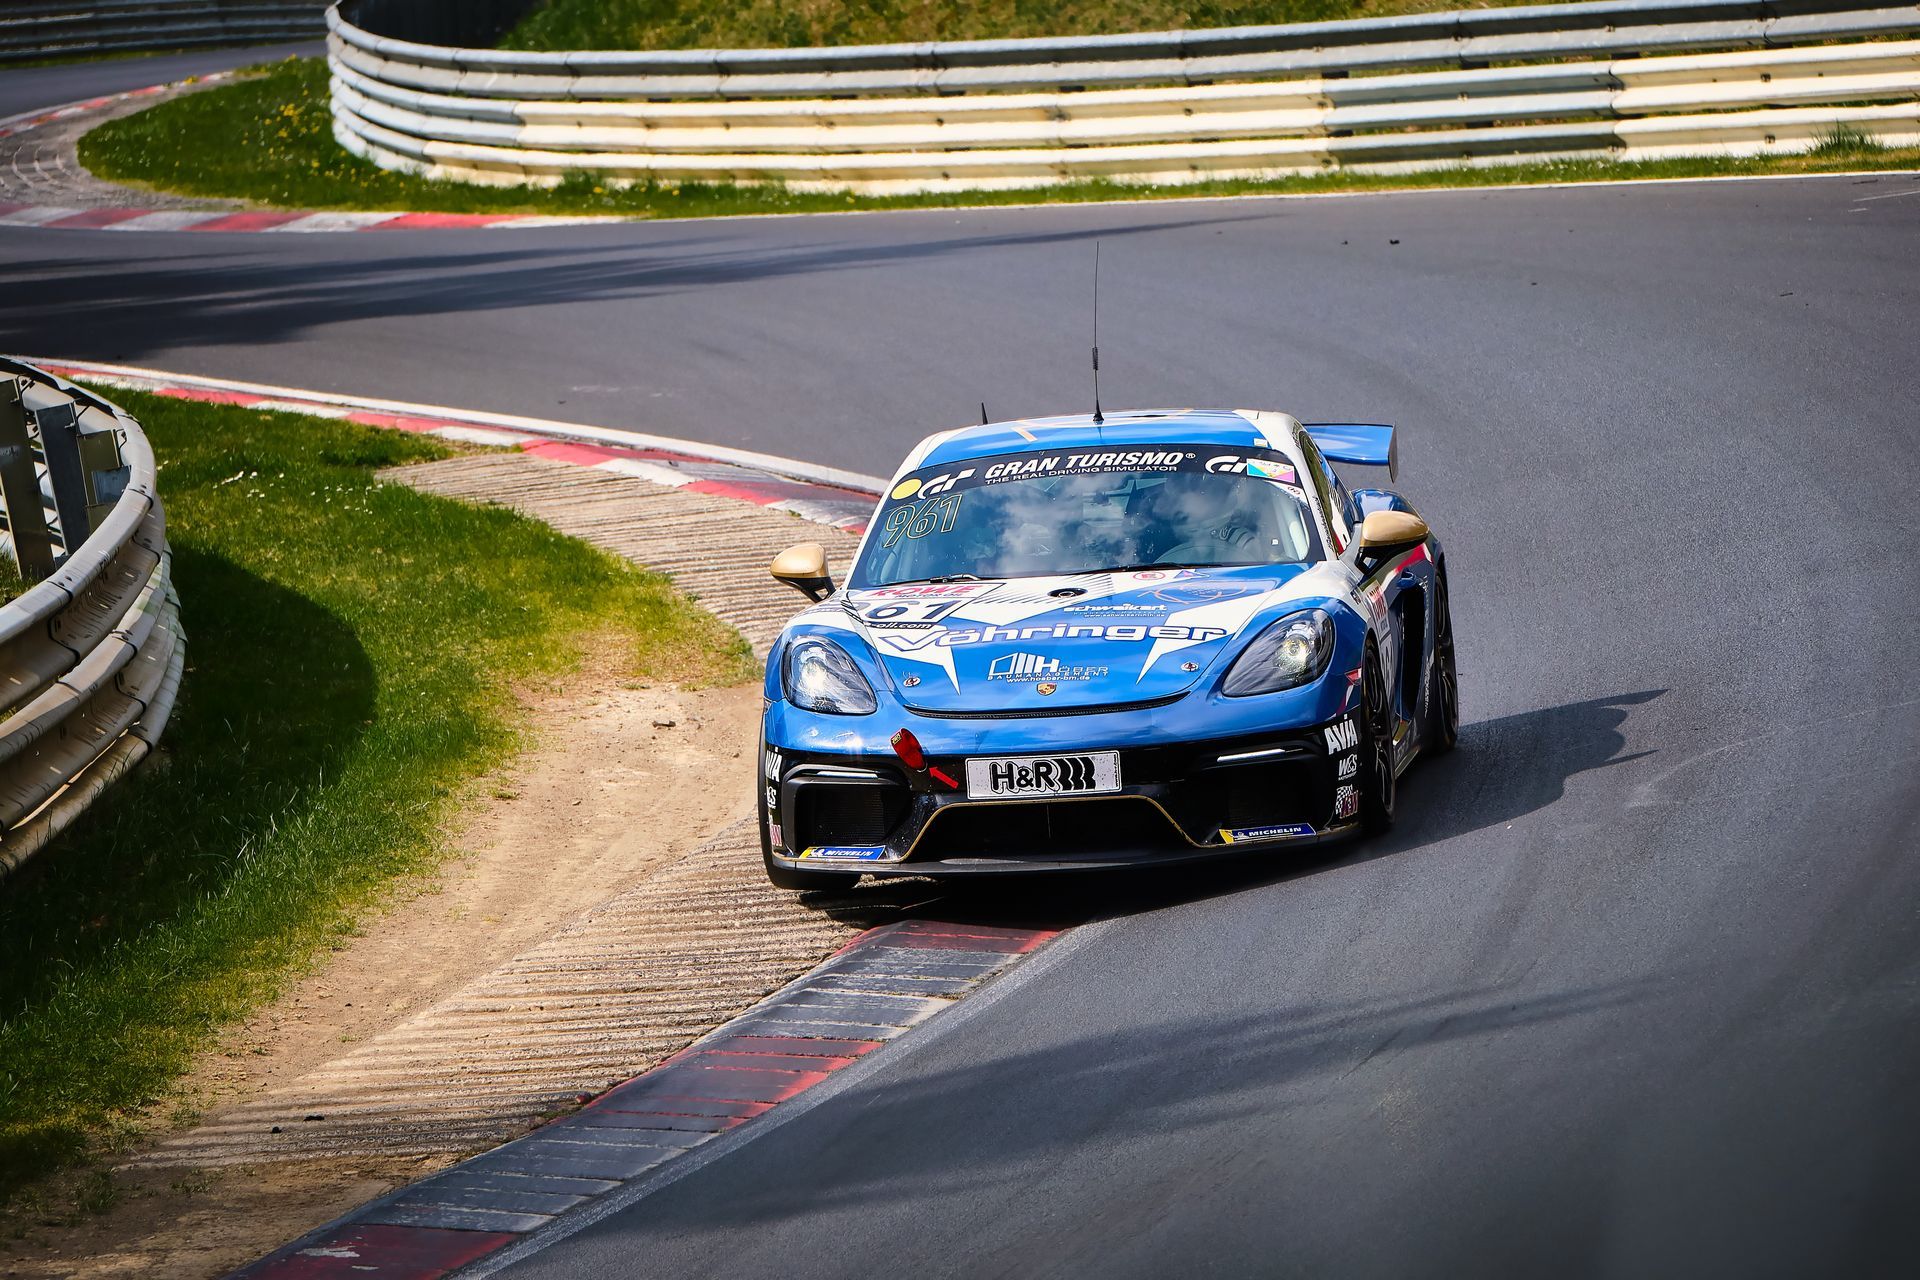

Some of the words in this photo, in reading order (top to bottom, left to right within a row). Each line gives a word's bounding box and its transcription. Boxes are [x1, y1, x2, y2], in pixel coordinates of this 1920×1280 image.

[984, 456, 1060, 479] GRAN
[985, 477, 1010, 485] THE
[1012, 472, 1045, 481] REAL
[1048, 467, 1100, 476] DRIVING
[883, 494, 962, 548] 961
[871, 585, 983, 597] ROWE
[879, 624, 1227, 652] Vöhringer
[987, 671, 1109, 681] BAUMANAGEMENT
[1338, 754, 1358, 776] W&S
[989, 760, 1061, 794] H&R
[1248, 827, 1302, 837] MICHELIN
